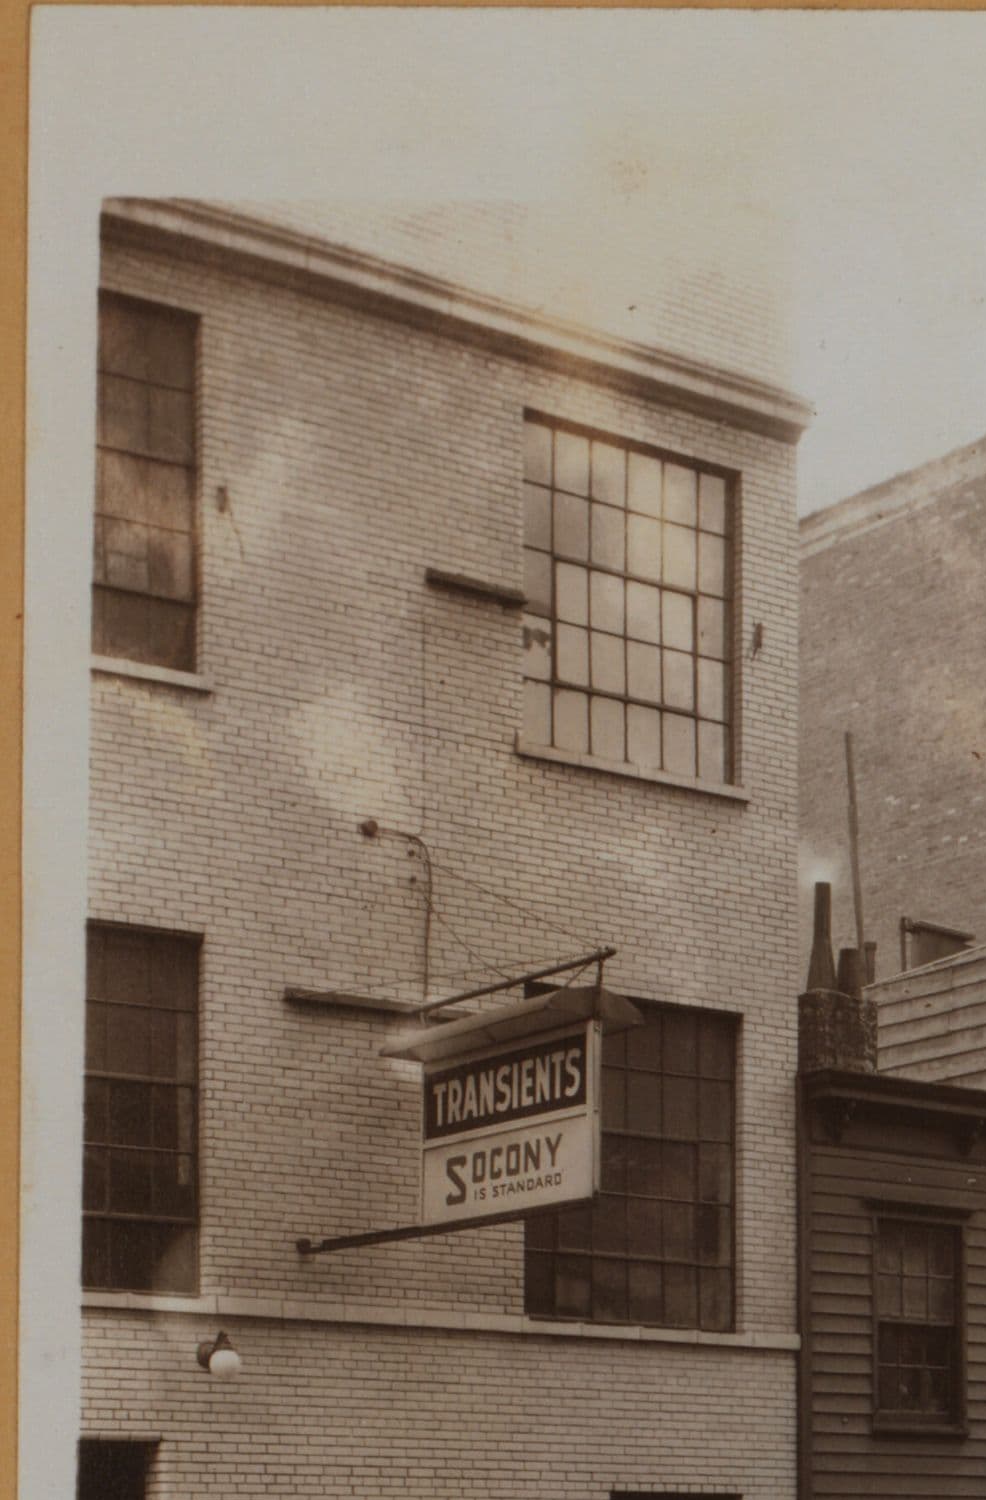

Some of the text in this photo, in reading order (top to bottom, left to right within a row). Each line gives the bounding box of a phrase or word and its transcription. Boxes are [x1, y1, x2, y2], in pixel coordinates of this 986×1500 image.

[433, 1048, 582, 1127] TRANSIENTS
[446, 1133, 563, 1206] SOCONY
[473, 1172, 563, 1201] IS STANDARD
